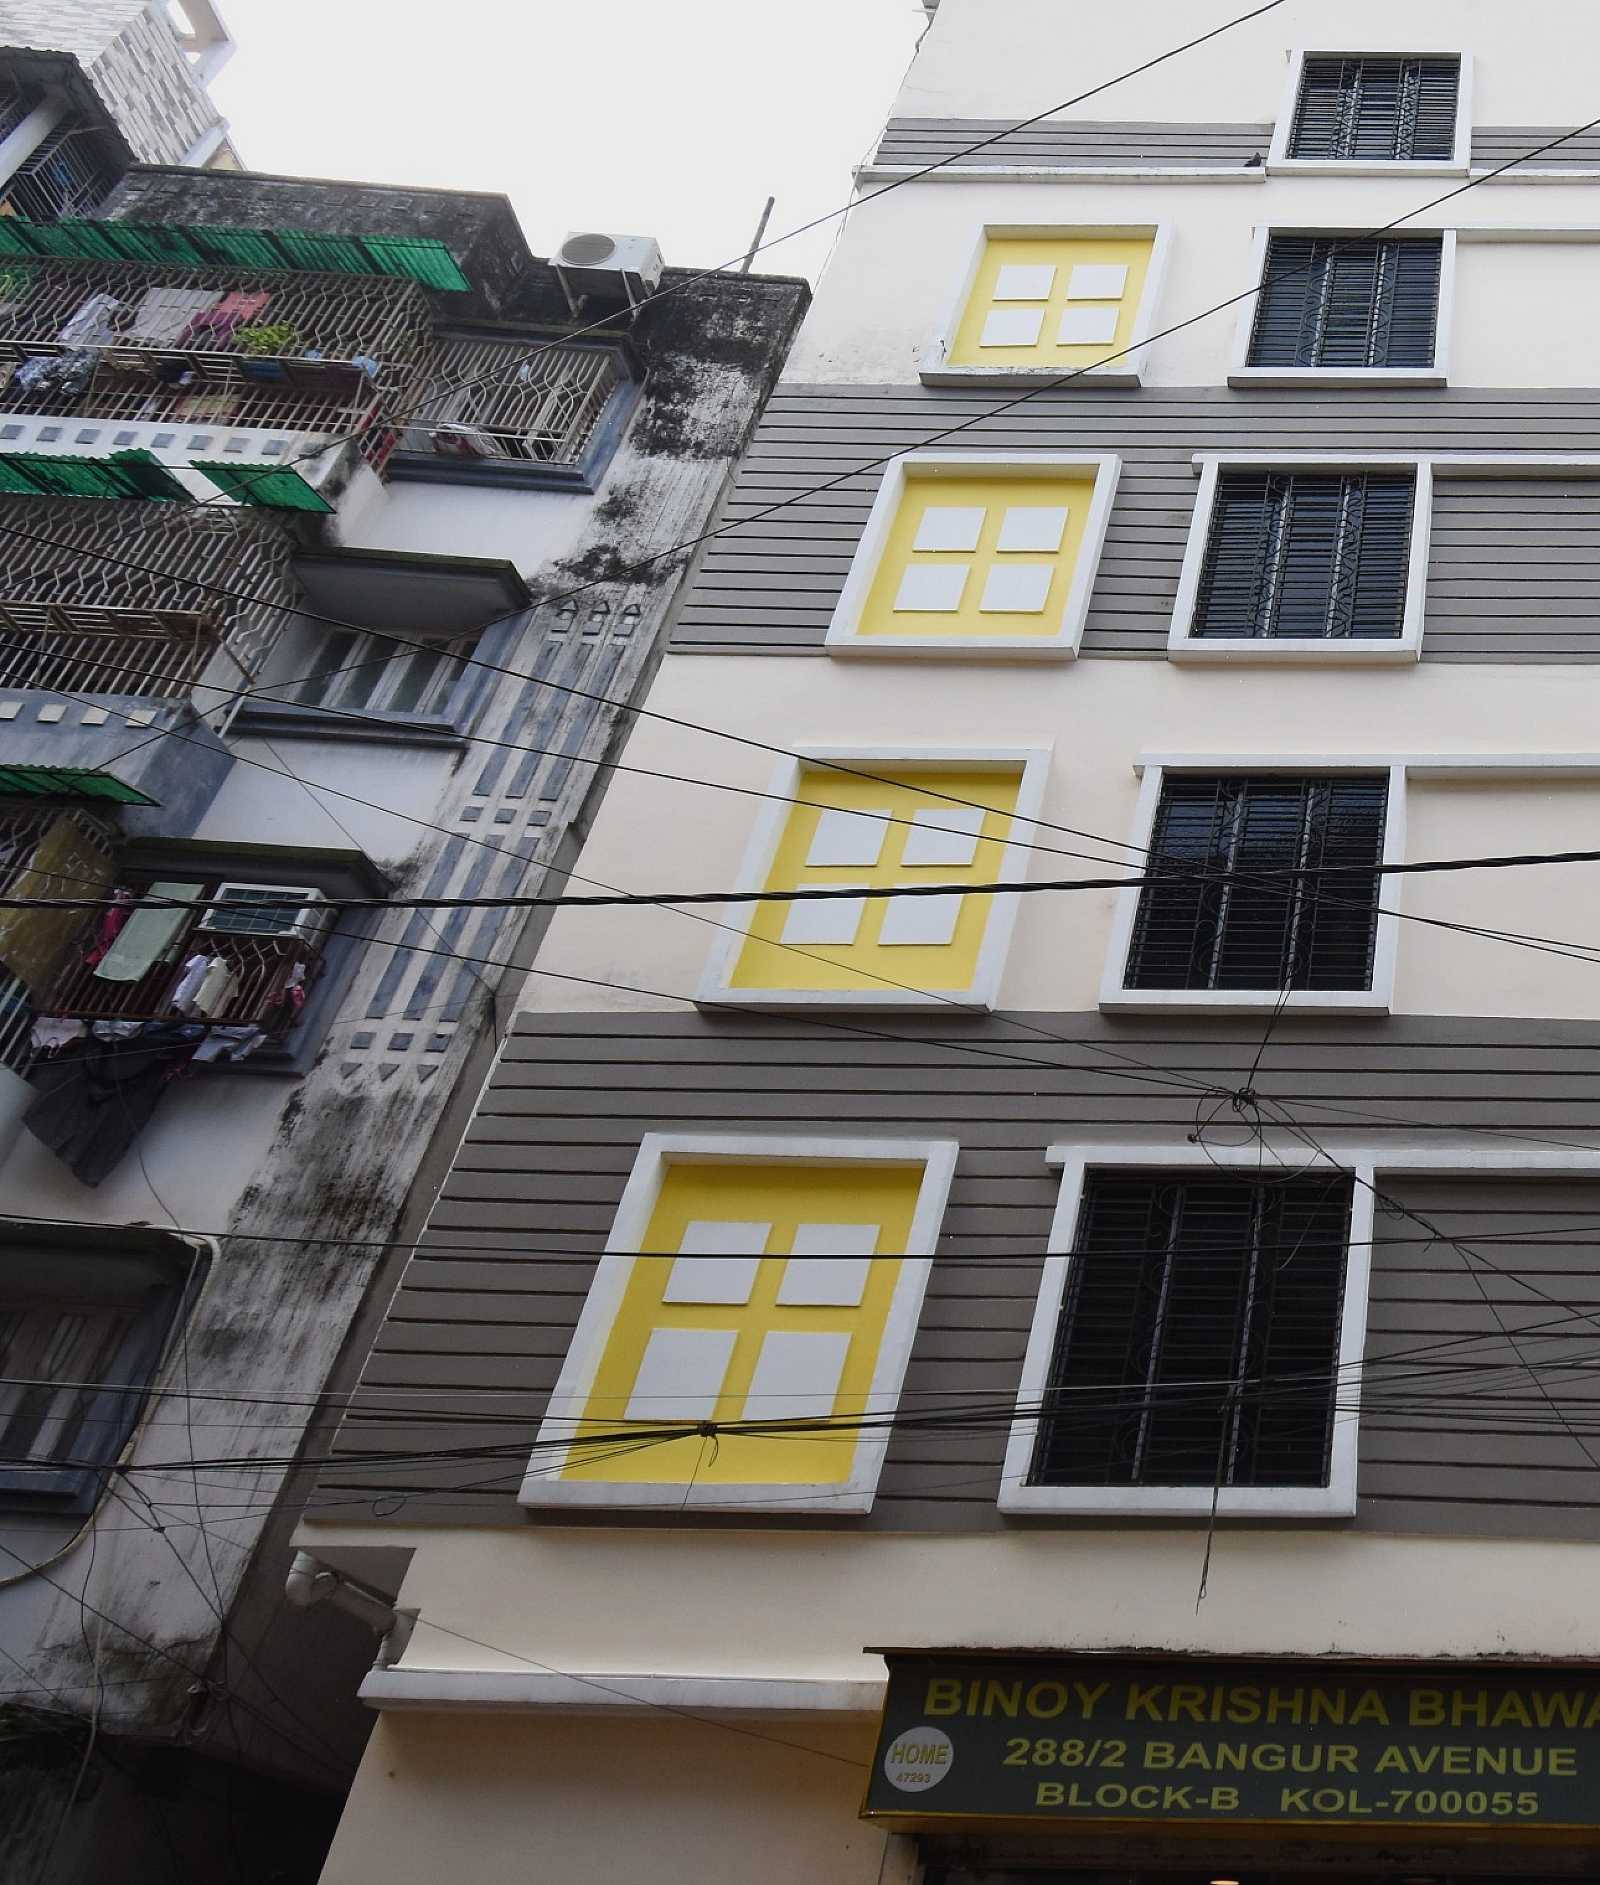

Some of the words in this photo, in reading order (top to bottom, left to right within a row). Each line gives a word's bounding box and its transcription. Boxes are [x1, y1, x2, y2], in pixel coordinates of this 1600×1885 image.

[924, 1679, 1109, 1719] BINOY
[1125, 1684, 1390, 1725] KRISHNA
[891, 1743, 948, 1765] HOME
[1003, 1738, 1127, 1768] 288/2
[1143, 1743, 1359, 1773] BANGUR
[1374, 1748, 1577, 1776] AVENUE
[1035, 1783, 1240, 1811] BLOCK-B
[1280, 1789, 1539, 1815] KOL-700055
